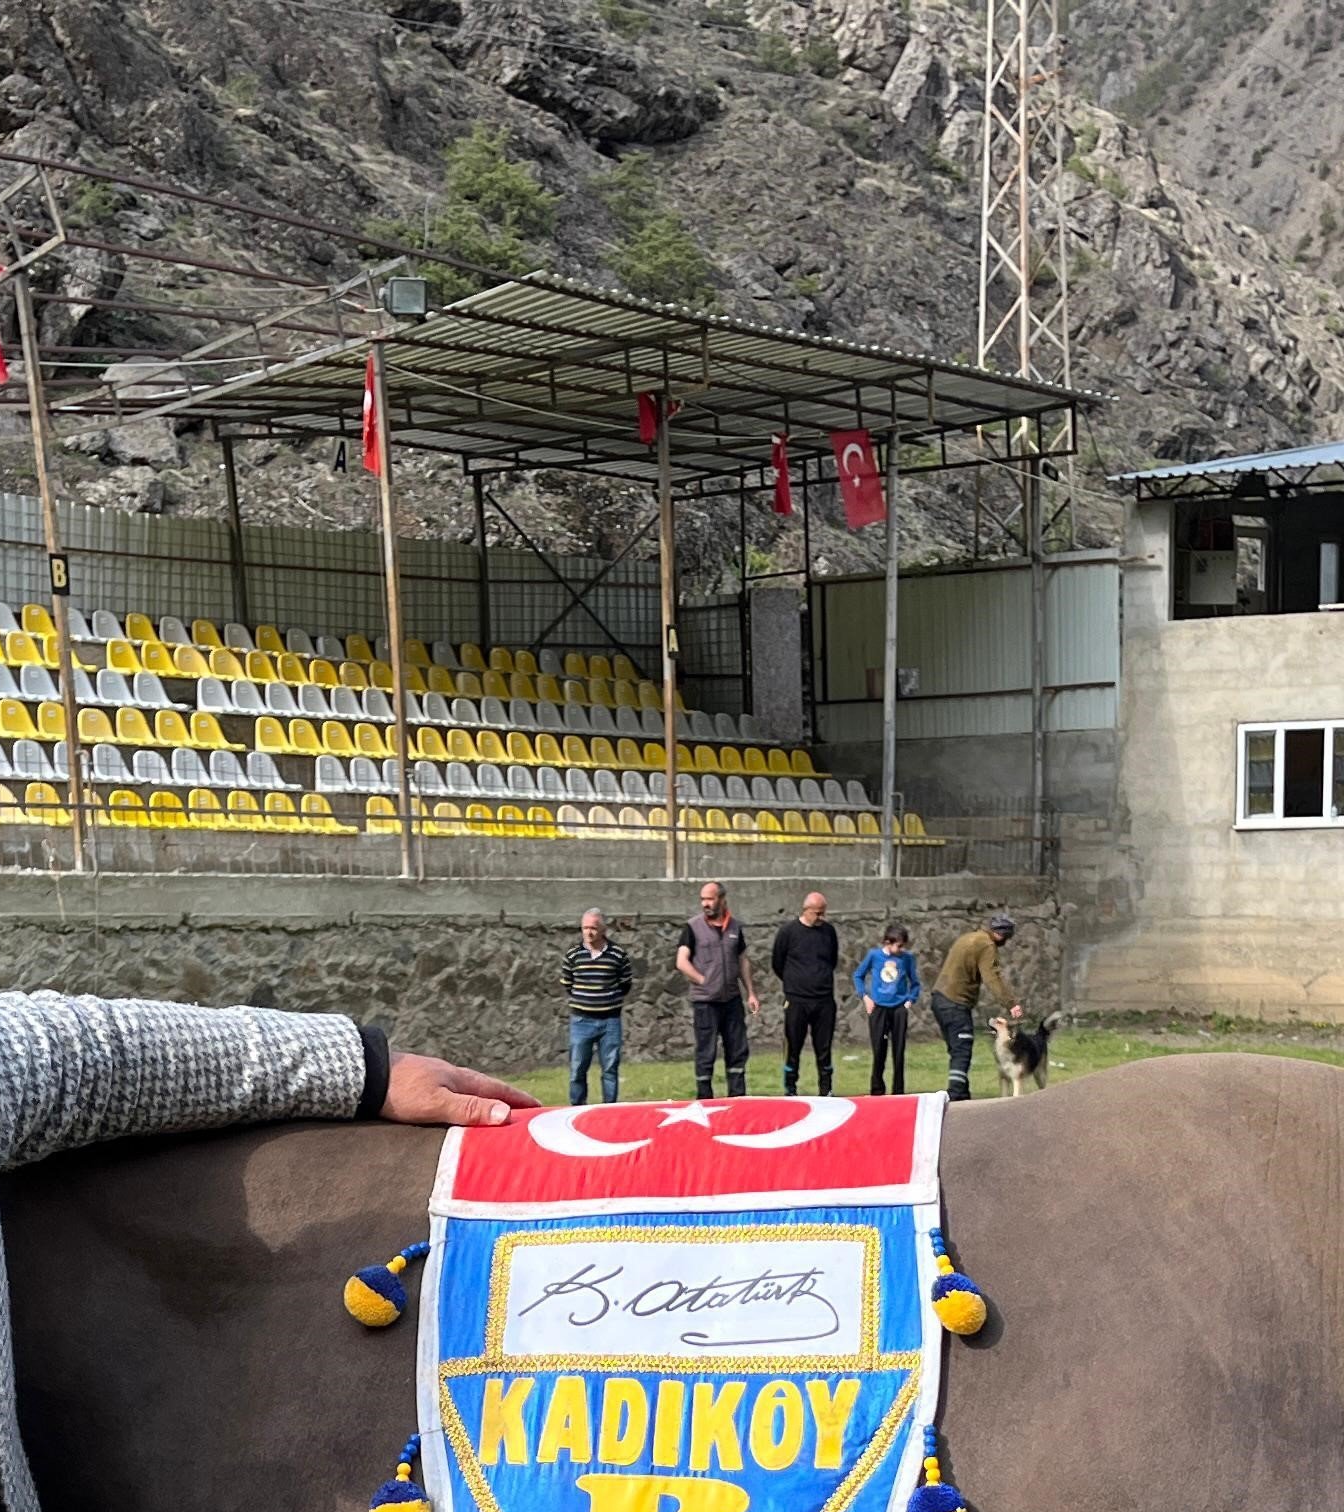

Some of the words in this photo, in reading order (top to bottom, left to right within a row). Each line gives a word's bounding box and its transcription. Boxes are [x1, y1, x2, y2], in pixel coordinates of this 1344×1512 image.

[333, 441, 347, 473] A
[52, 558, 67, 588] B
[668, 628, 679, 652] A
